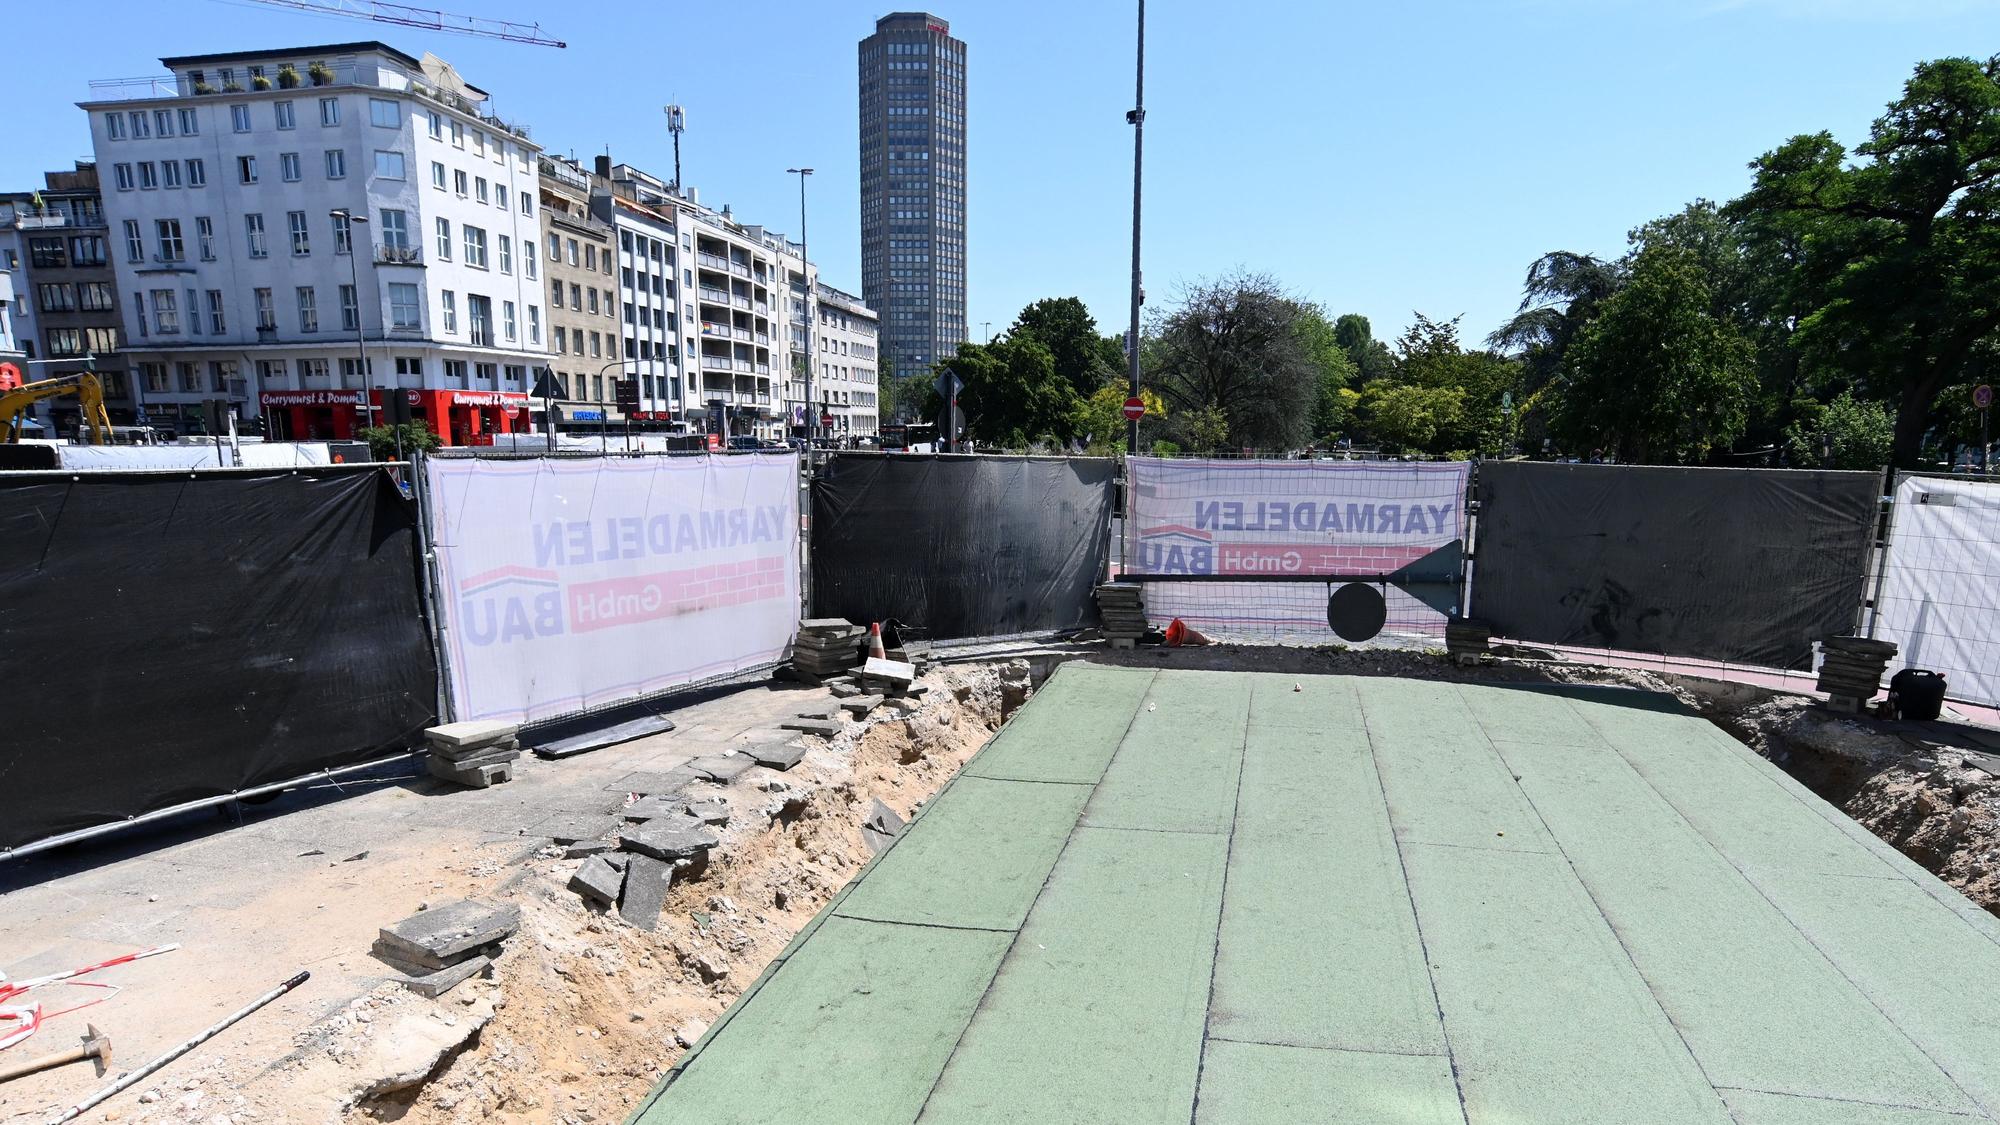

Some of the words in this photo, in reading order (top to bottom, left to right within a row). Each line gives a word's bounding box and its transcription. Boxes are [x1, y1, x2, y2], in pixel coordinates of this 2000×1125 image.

[262, 393, 315, 406] Currywurst
[318, 393, 325, 404] &
[328, 394, 358, 405] Pomm
